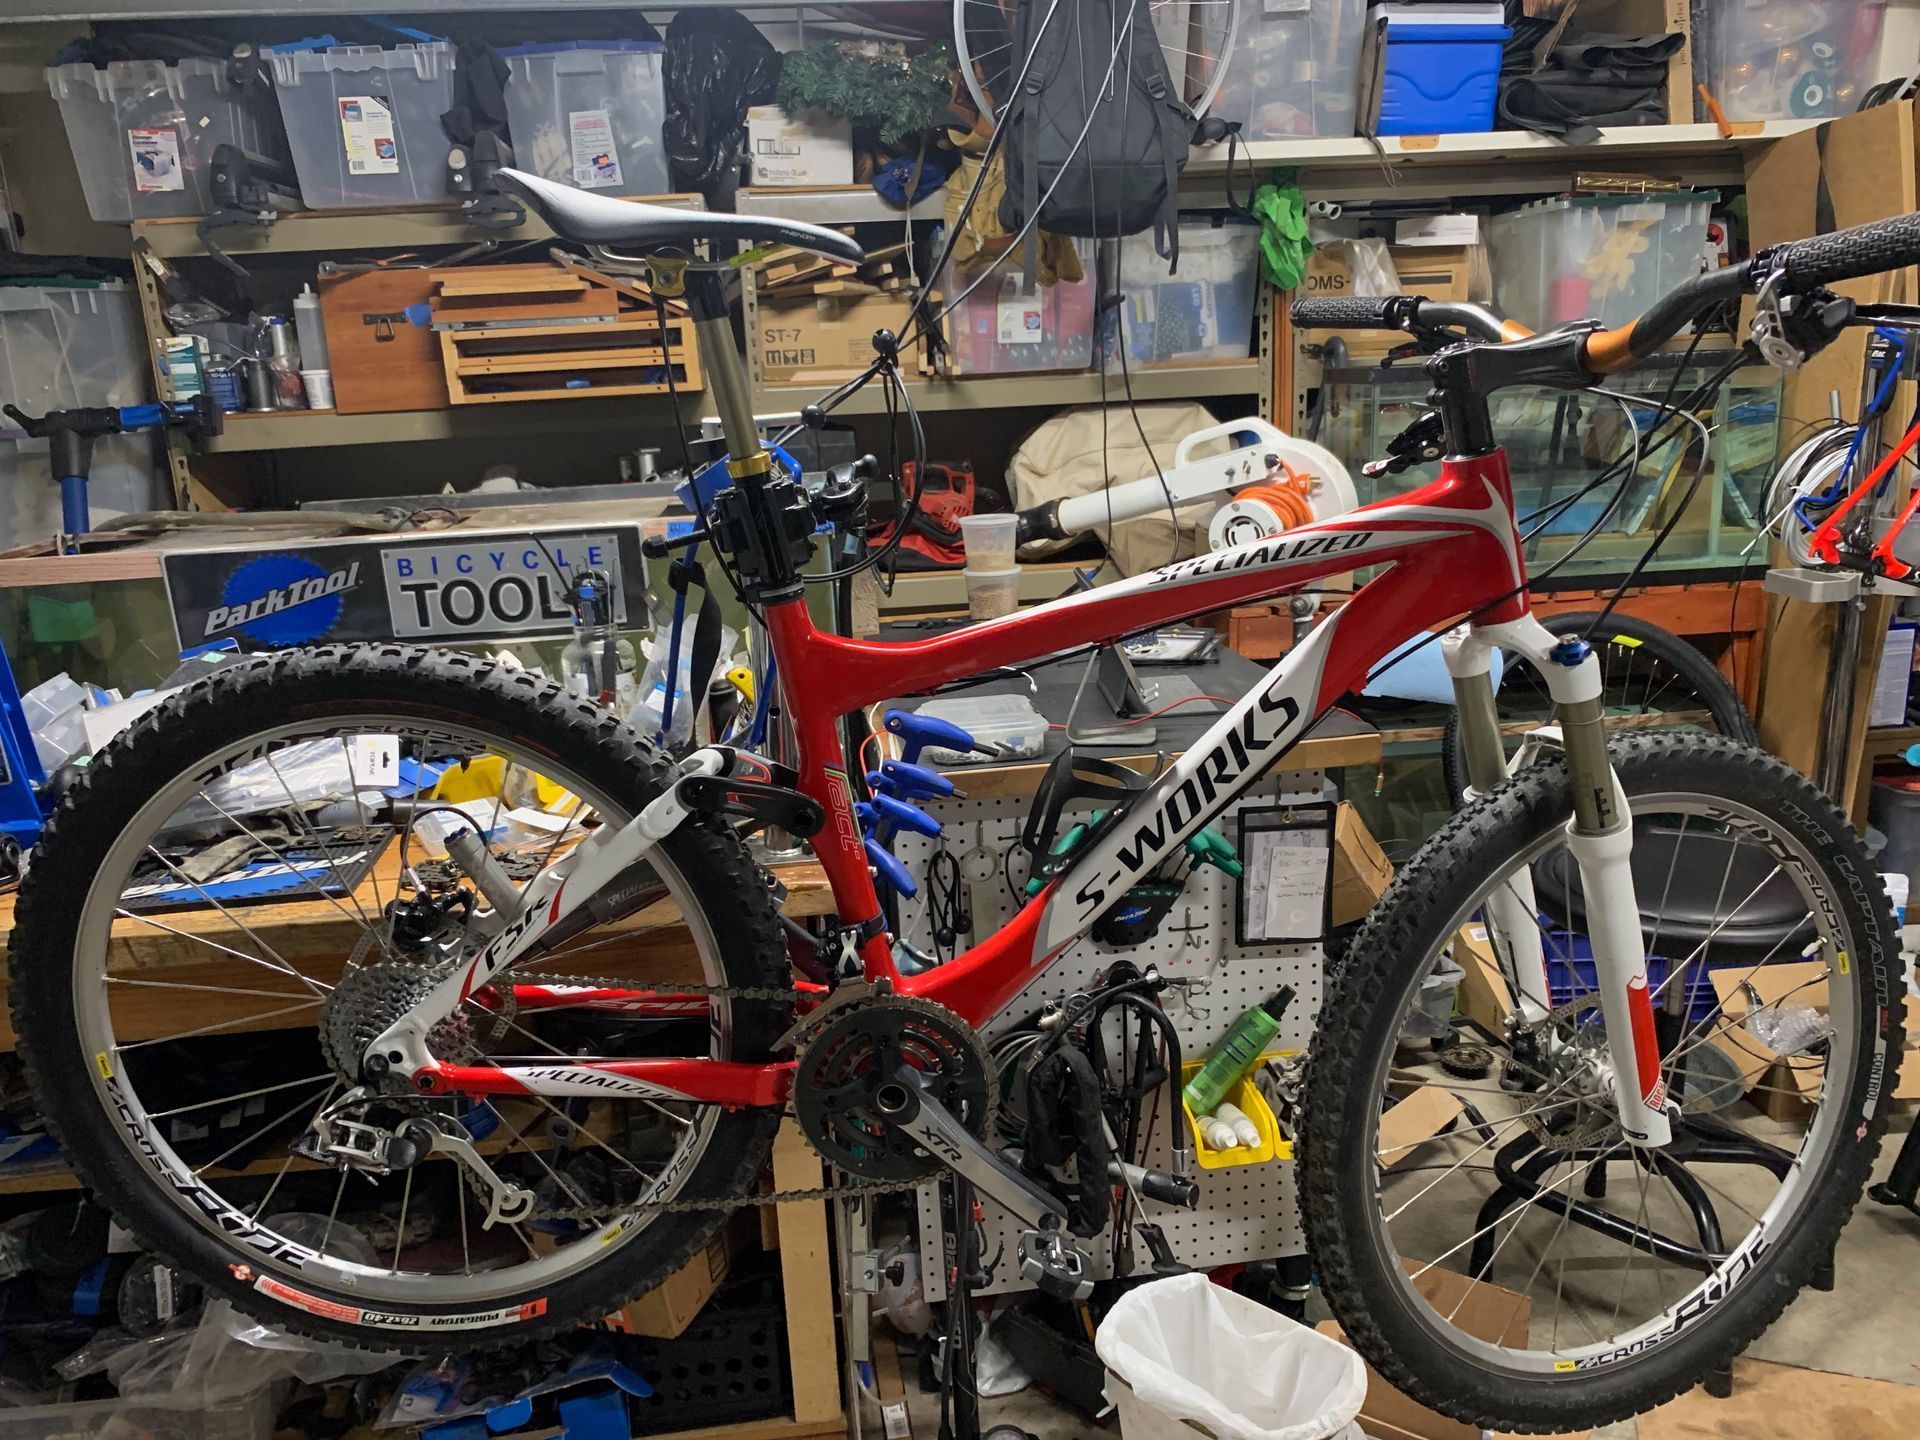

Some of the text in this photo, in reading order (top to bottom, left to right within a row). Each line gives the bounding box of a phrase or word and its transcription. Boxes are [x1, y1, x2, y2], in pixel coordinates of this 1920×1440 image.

[764, 329, 801, 343] ST-7
[397, 546, 605, 577] BICYCLE
[1147, 532, 1374, 585] SPECIALIZED
[204, 561, 360, 636] ParkTool
[1075, 673, 1301, 923] S-WORKS
[1779, 800, 1889, 1006] THE CAPTAIN
[485, 895, 551, 962] FSR
[525, 1067, 674, 1101] SPECIALIZED
[918, 1125, 963, 1162] XTR
[363, 1311, 420, 1325] 26x2.40
[428, 1310, 501, 1326] PURGATORY
